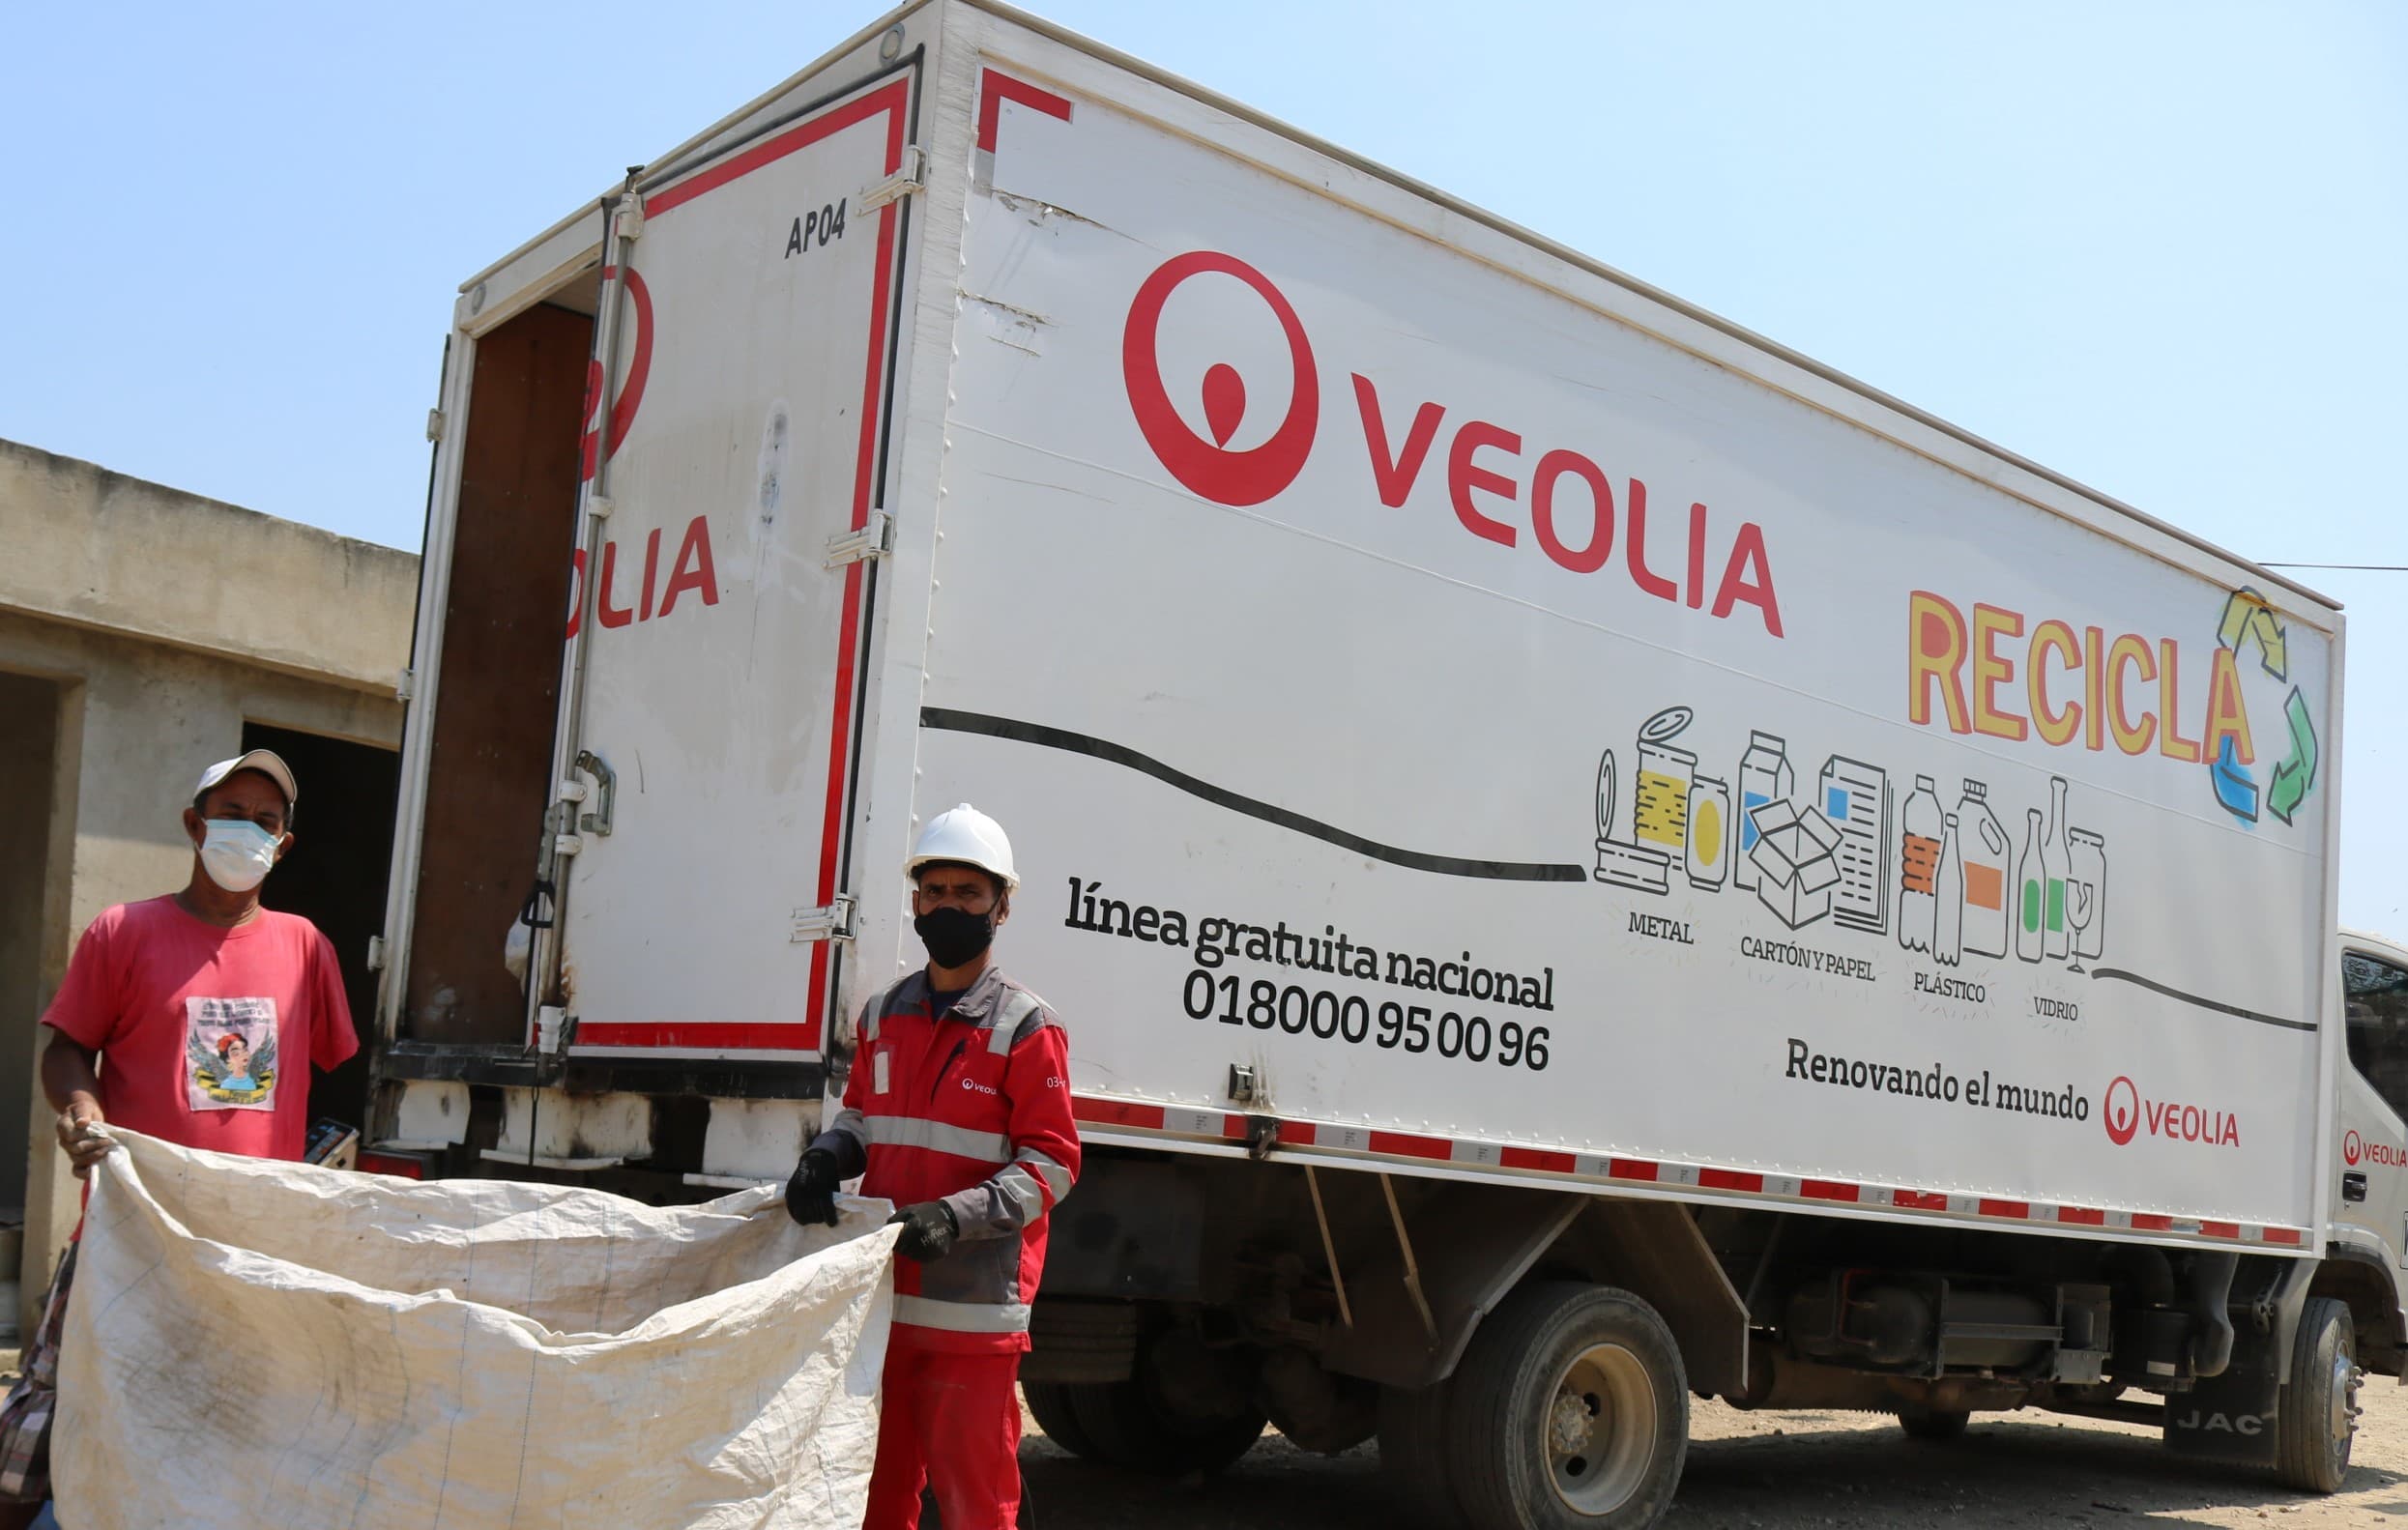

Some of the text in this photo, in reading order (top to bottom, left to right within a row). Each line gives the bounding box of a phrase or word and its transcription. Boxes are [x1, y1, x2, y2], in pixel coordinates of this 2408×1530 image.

[785, 197, 847, 259] AP04
[1351, 373, 1784, 639] VEOLIA
[1909, 590, 2255, 765] RECICLA
[1064, 876, 1554, 1012] línea gratuita nacional
[1628, 911, 1695, 945] METAL
[1741, 936, 1876, 982] CARTÓN Y PAPEL
[1183, 968, 1370, 1044] 018000
[1913, 969, 1986, 1004] PLÁSTICO
[2033, 996, 2078, 1022] VIDRIO
[1785, 1037, 2089, 1121] Renovando el mundo
[2146, 1101, 2239, 1146] VEOLIA
[2363, 1142, 2407, 1168] VEOLIA
[2177, 1410, 2263, 1435] JAC
